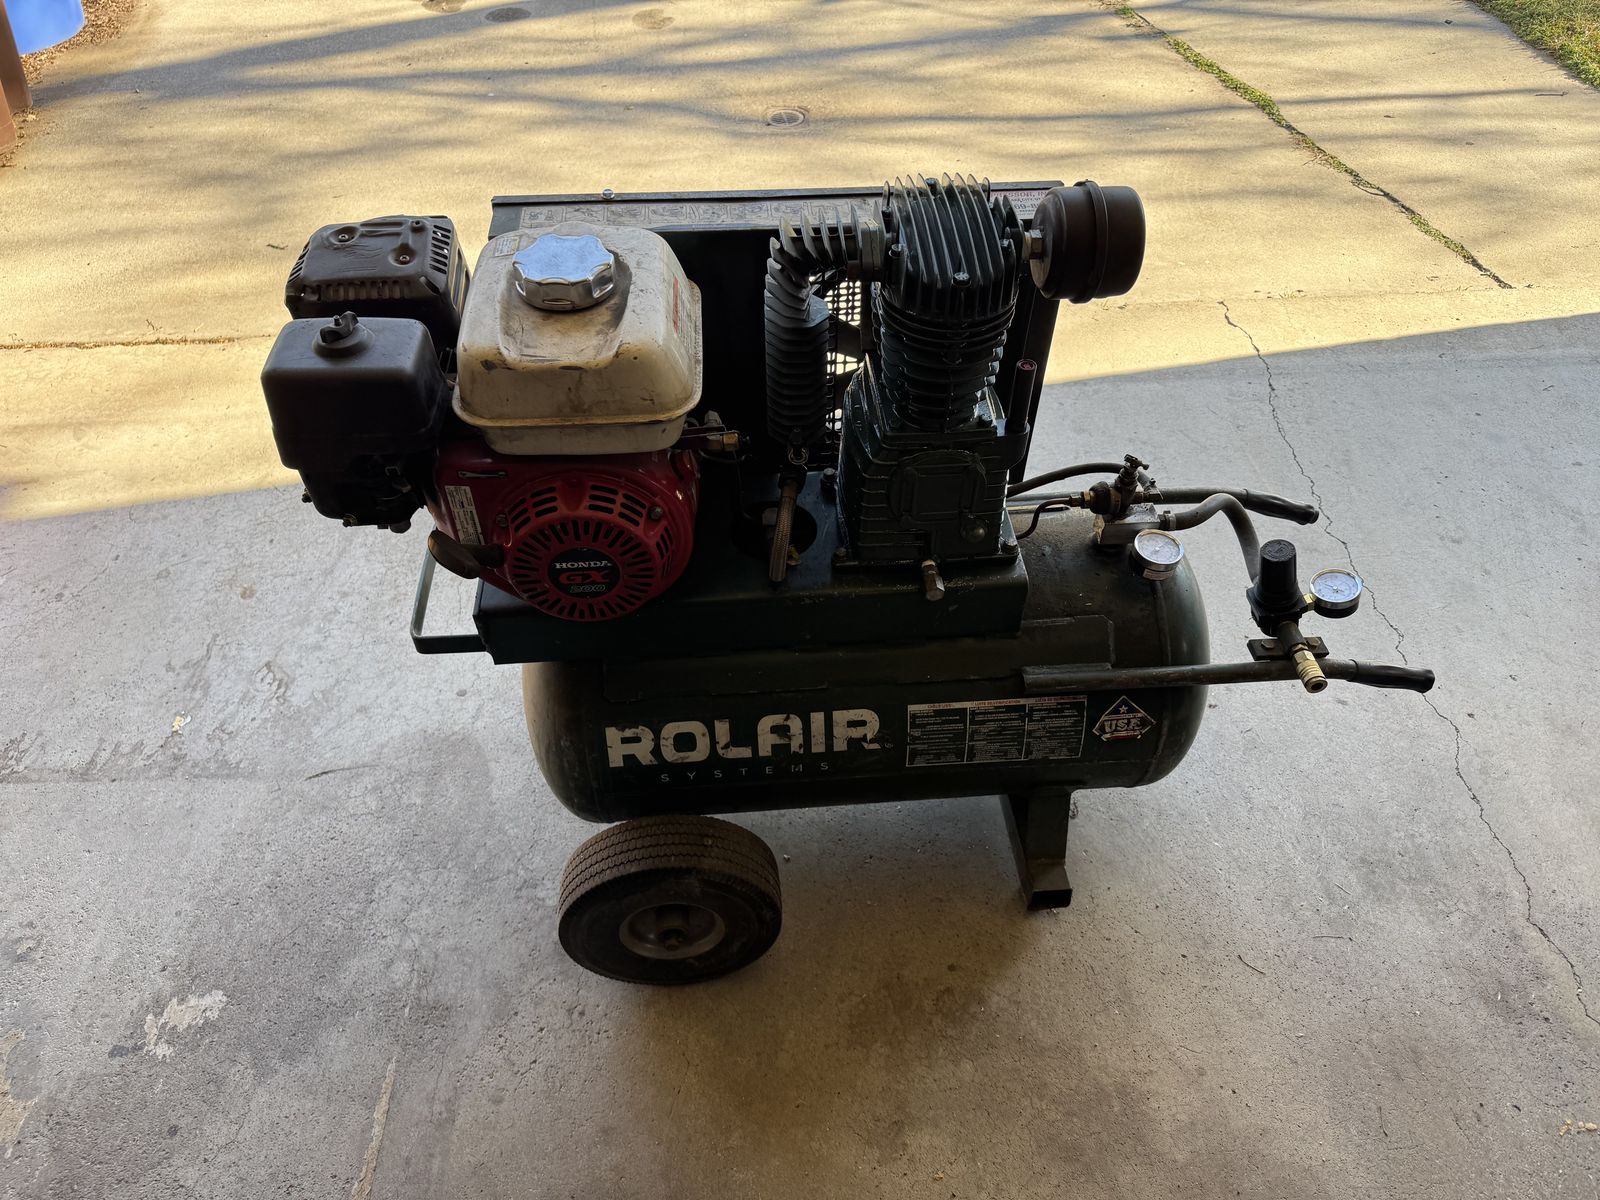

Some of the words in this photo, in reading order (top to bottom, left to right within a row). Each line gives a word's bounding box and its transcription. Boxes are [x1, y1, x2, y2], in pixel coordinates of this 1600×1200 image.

[554, 560, 612, 569] HONDA
[560, 569, 609, 584] GX
[604, 708, 881, 768] ROLAIR
[660, 761, 830, 783] SYSTEMS
